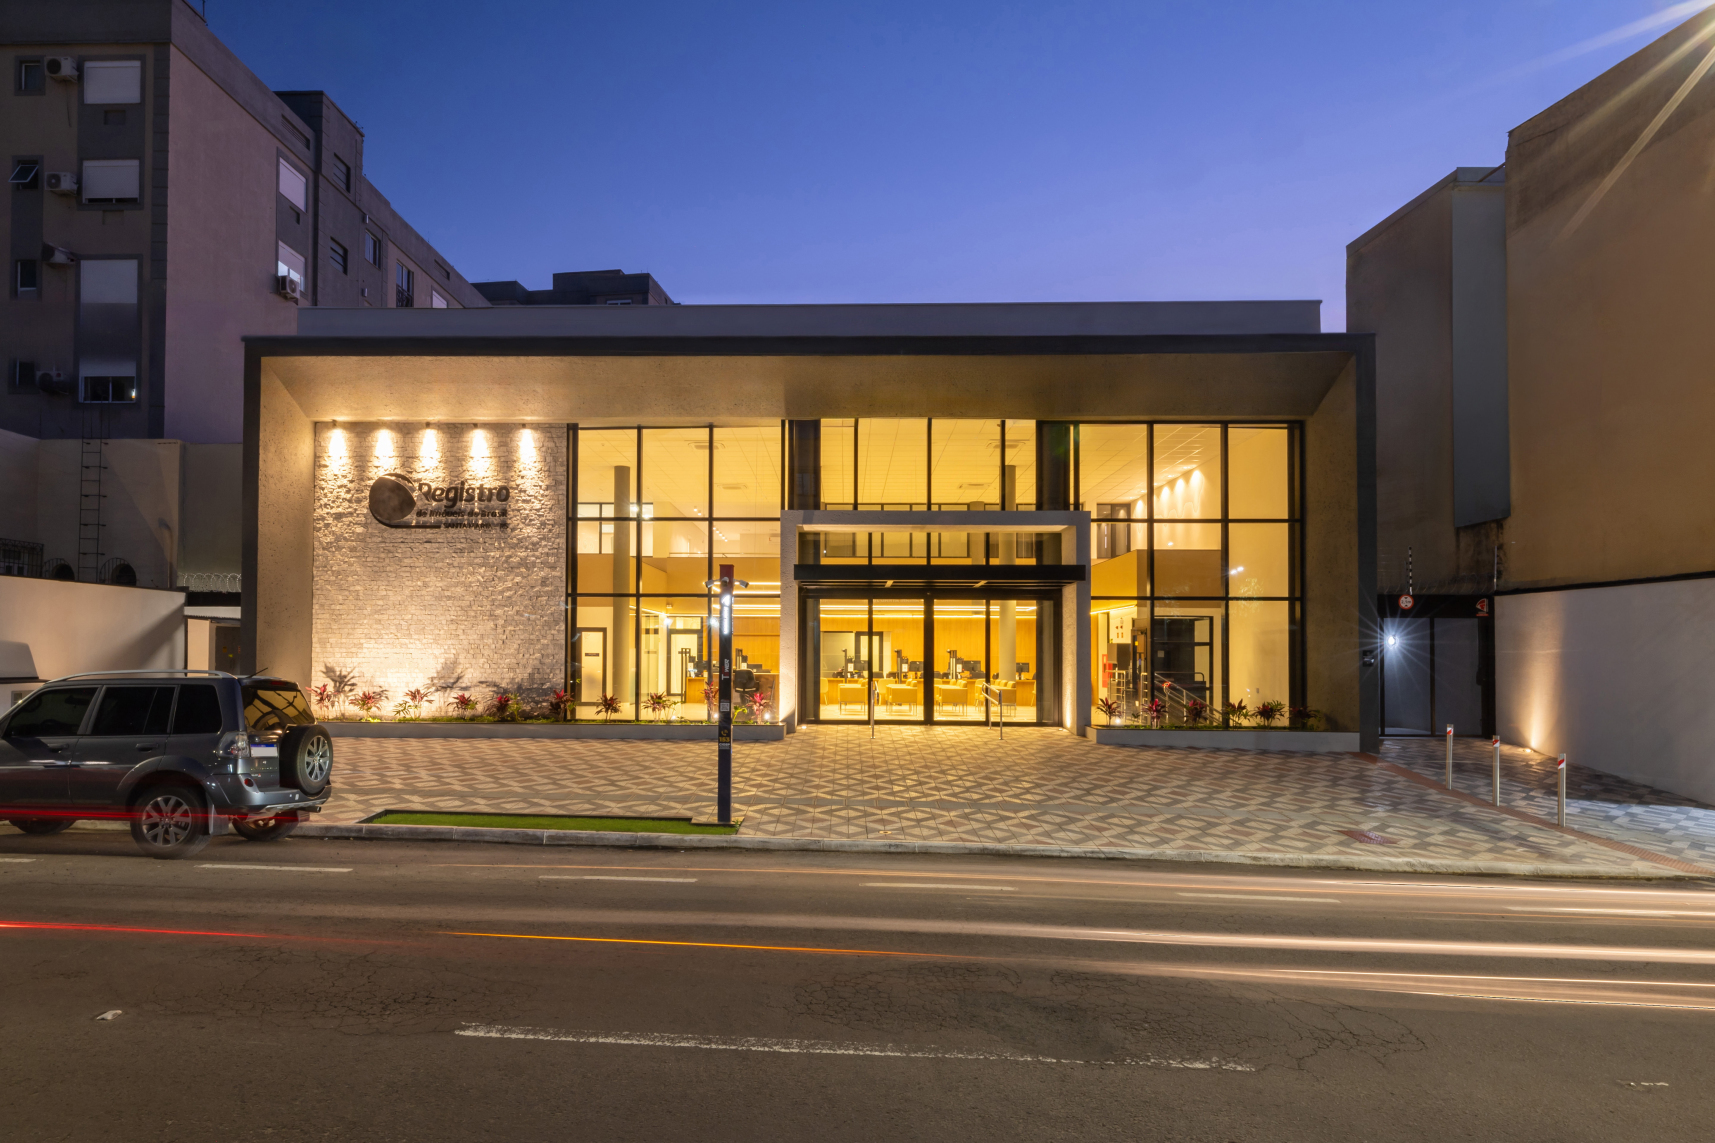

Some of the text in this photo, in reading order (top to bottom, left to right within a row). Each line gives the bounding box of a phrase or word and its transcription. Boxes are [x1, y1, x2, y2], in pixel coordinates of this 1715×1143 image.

[418, 481, 510, 508] Registro
[416, 509, 428, 517] de
[480, 509, 508, 517] Brasil
